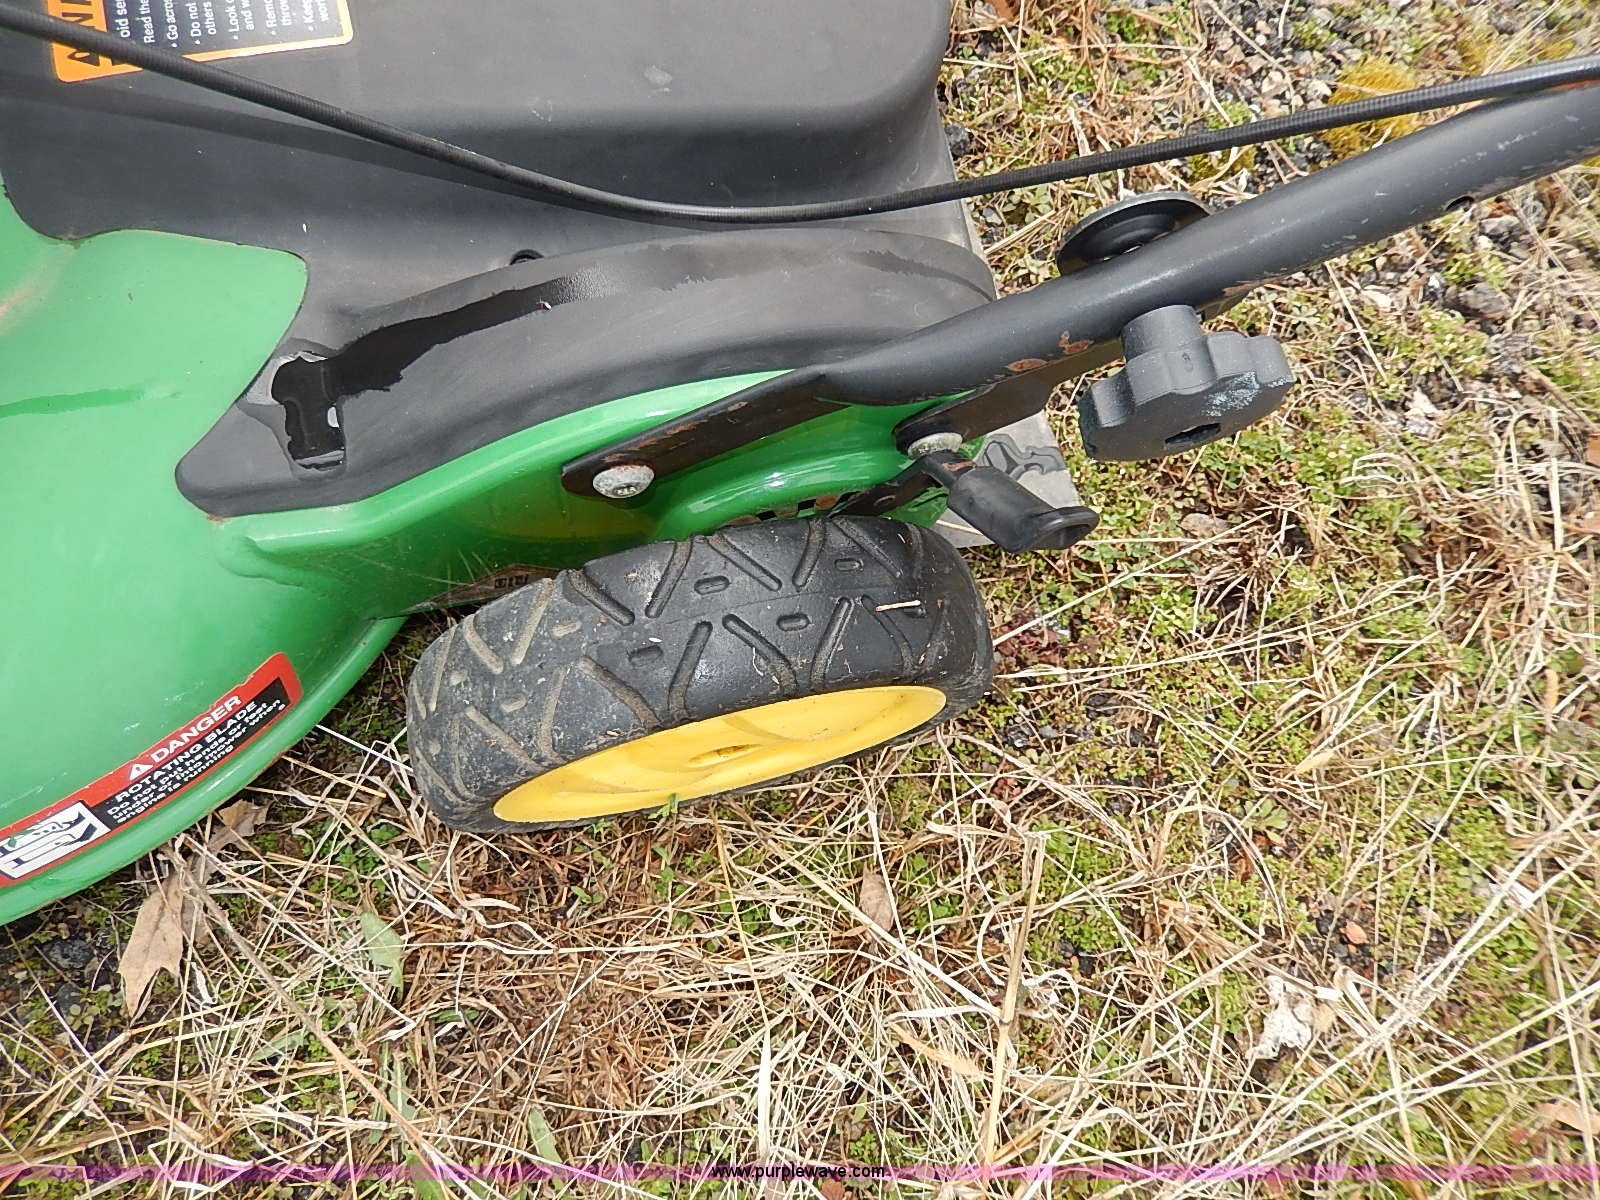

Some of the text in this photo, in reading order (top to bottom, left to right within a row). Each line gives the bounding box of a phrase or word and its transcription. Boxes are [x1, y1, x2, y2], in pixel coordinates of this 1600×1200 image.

[138, 16, 155, 43] Read
[166, 24, 179, 40] Go
[185, 2, 202, 37] Do not
[203, 1, 217, 35] others
[224, 5, 240, 32] Look
[240, 10, 255, 30] and
[150, 695, 241, 763] DANGER
[107, 801, 130, 815] Do
[132, 784, 157, 801] not
[160, 766, 183, 784] put
[185, 736, 226, 766] hands
[228, 723, 242, 736] or
[244, 702, 267, 723] feet
[112, 699, 281, 820] under or into mower when
[115, 701, 257, 802] ROTATING BLADE
[117, 744, 234, 824] engine is running
